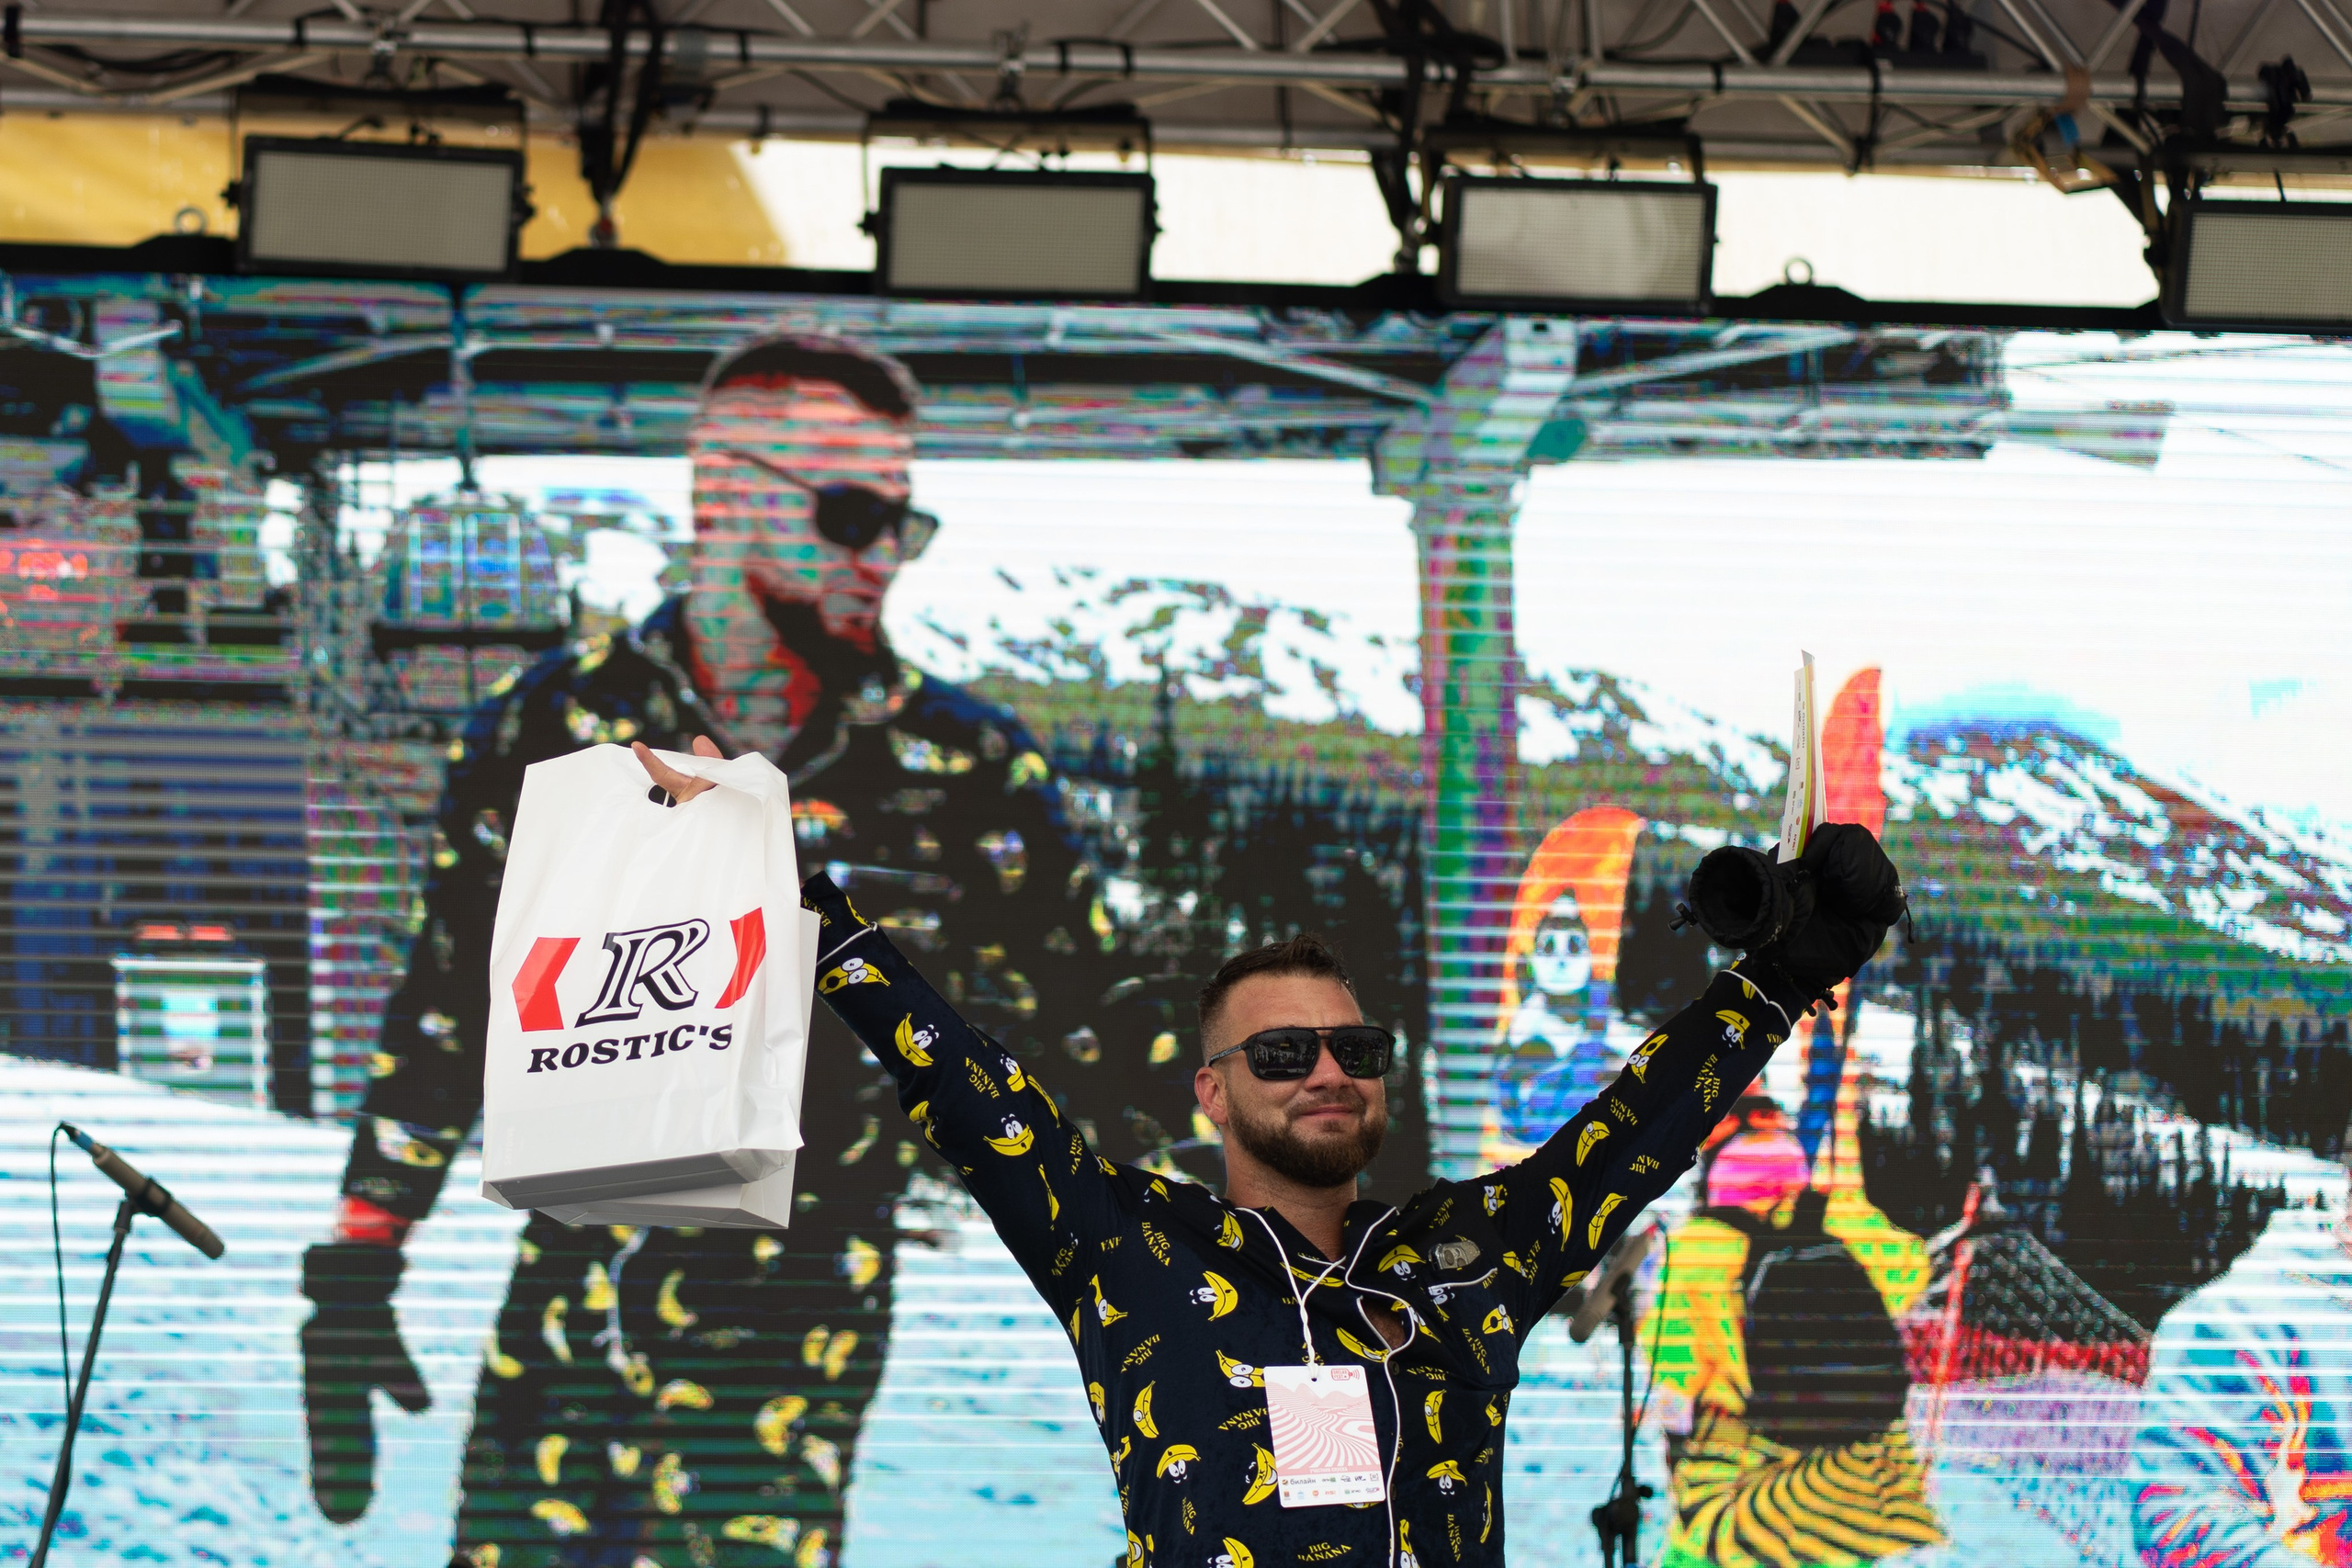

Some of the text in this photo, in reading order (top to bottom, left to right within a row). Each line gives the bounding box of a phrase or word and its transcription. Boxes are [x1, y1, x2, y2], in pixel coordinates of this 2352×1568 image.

[574, 918, 710, 1028] R
[526, 1022, 733, 1074] ROSTIC'S
[965, 1056, 1001, 1099] BANANA
[968, 1074, 987, 1093] BIG
[1712, 1077, 1721, 1098] BIG
[1610, 1104, 1625, 1122] BIG
[1069, 1134, 1078, 1156] BIG
[1141, 1222, 1171, 1267] BANANA
[1154, 1231, 1170, 1250] BIG
[1120, 1334, 1160, 1373] BANANA
[1135, 1348, 1153, 1365] BIG
[1238, 1417, 1261, 1430] BIG
[1290, 1477, 1317, 1485] билайн
[1186, 1501, 1197, 1519] BIG
[1308, 1541, 1331, 1553] BIG
[1446, 1513, 1461, 1562] BANANA
